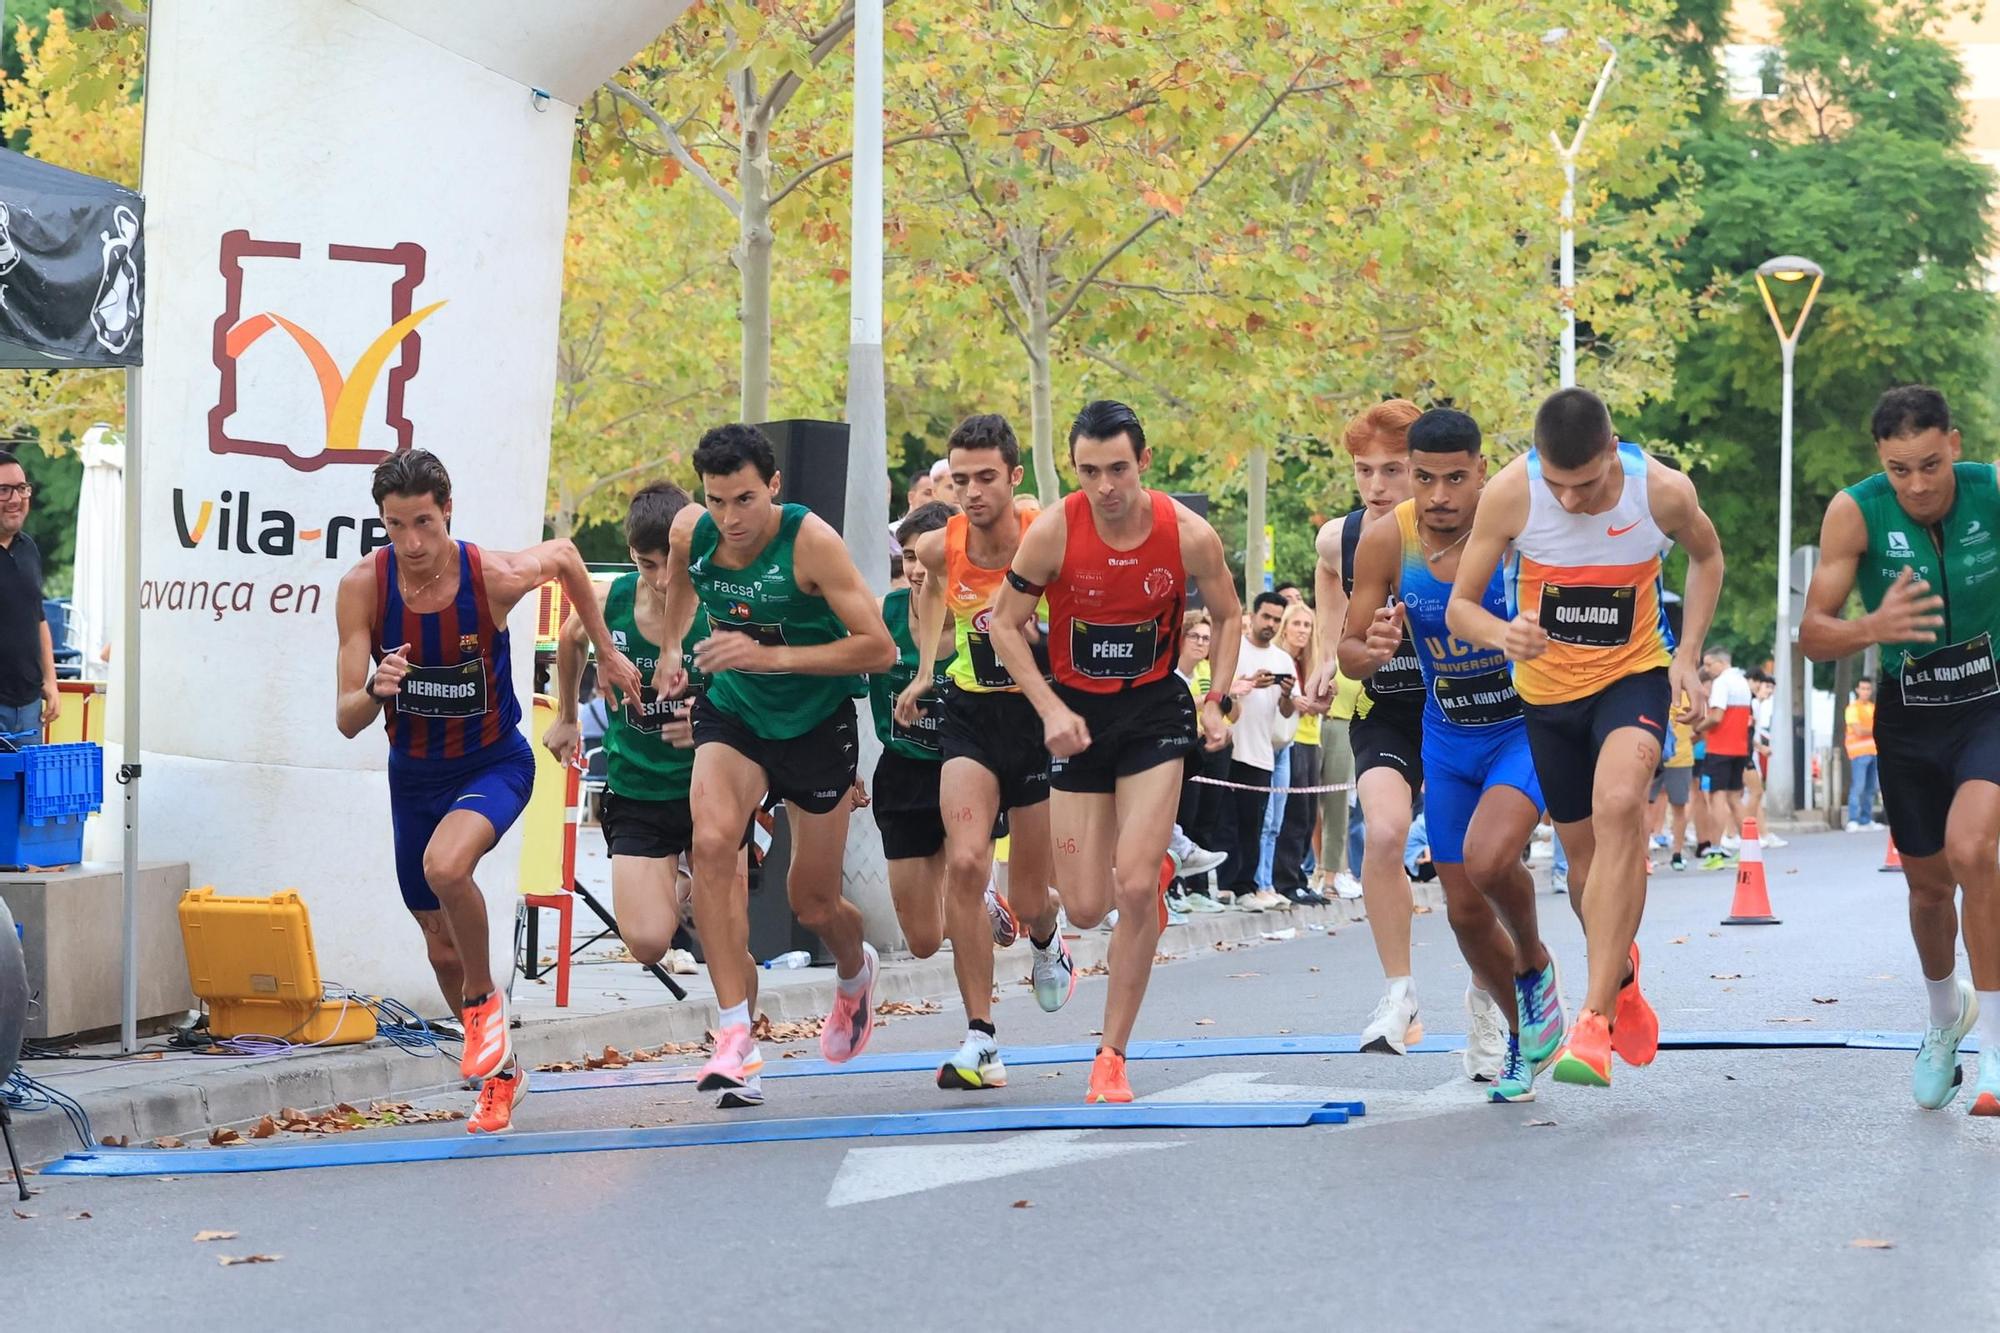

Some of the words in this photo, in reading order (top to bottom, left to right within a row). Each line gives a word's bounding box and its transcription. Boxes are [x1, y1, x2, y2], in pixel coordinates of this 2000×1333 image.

[173, 488, 393, 559] Vila-re
[141, 579, 255, 621] avança
[270, 583, 321, 614] en
[714, 581, 755, 599] Facsa
[1556, 606, 1618, 625] QUIJADA
[1092, 641, 1134, 658] PÉREZ
[1905, 670, 1931, 686] A.EL
[1934, 656, 1991, 681] KHAYAMI
[407, 680, 476, 699] HERREROS
[1442, 696, 1472, 709] M.EL
[1472, 686, 1518, 705] KHAYAM
